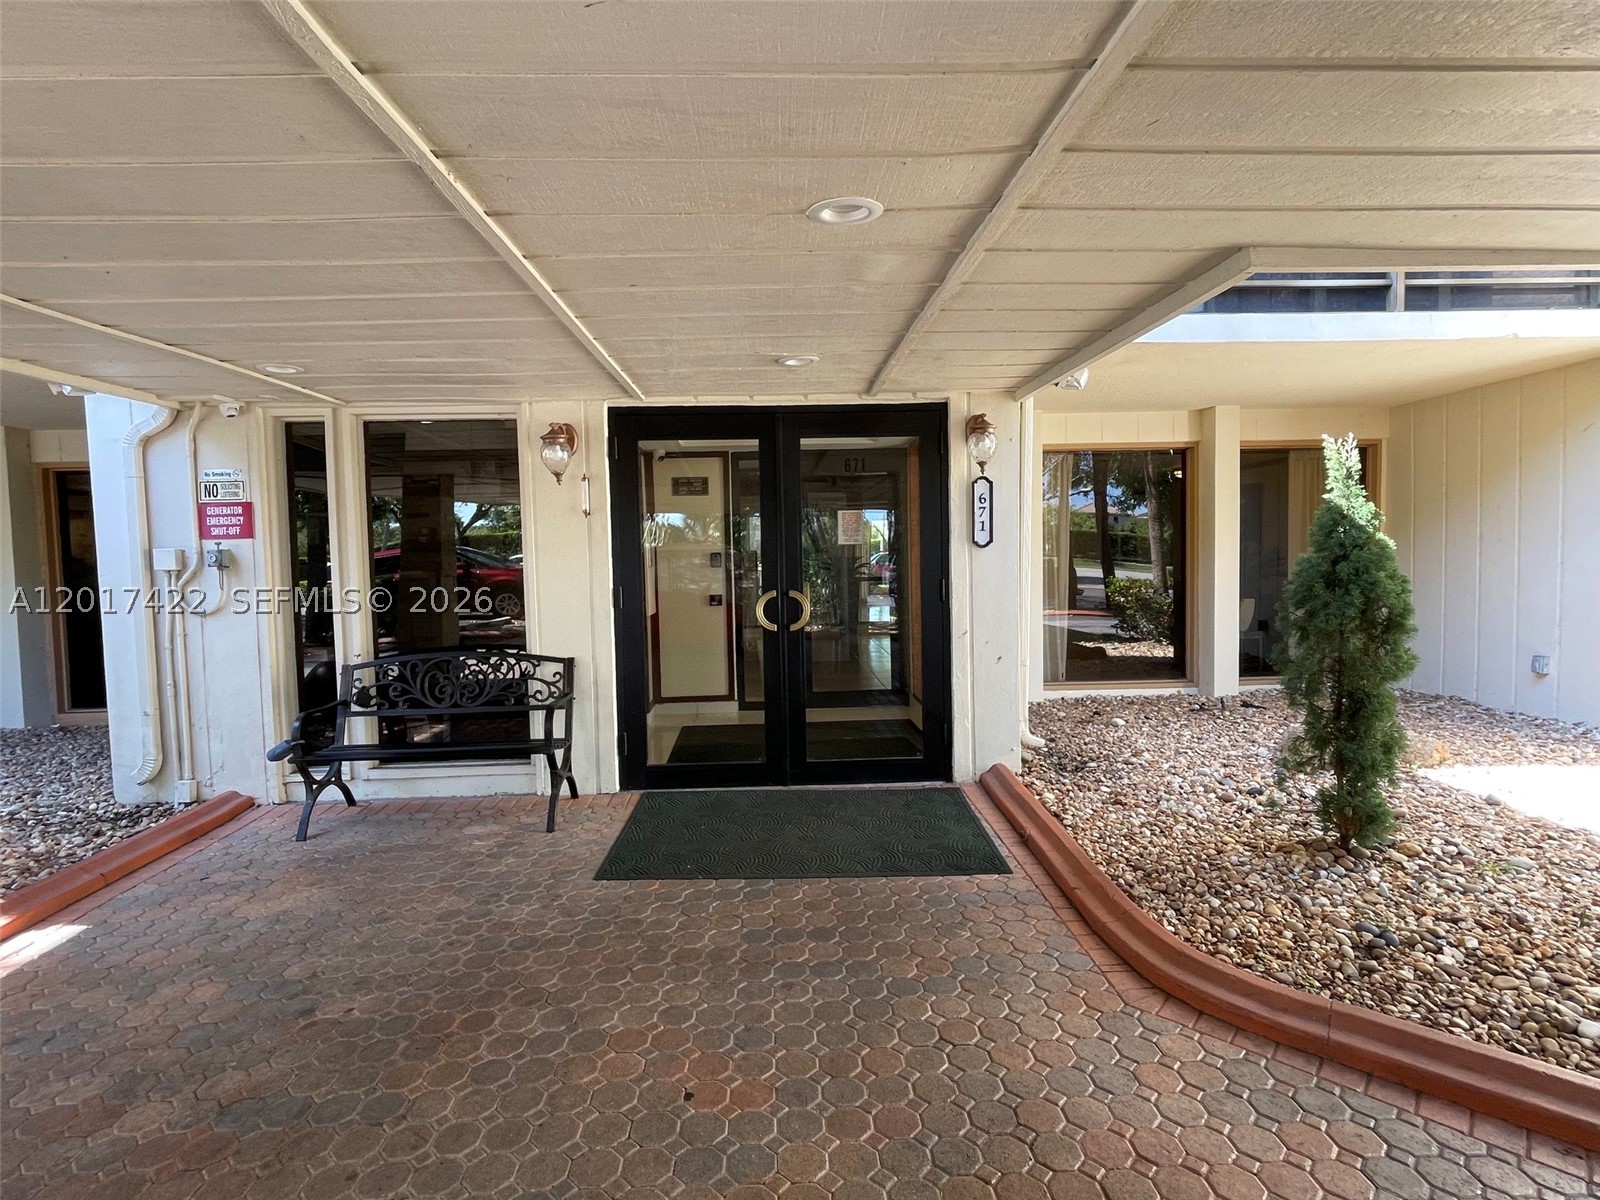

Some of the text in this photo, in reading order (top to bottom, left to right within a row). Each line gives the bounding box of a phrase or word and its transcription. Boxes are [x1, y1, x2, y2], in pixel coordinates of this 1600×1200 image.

[844, 458, 865, 472] 671
[204, 483, 219, 498] NO
[206, 506, 243, 515] GENERATOR
[978, 492, 987, 532] 671
[206, 516, 244, 525] EMERGENCY
[210, 526, 241, 536] SHUT-OFF
